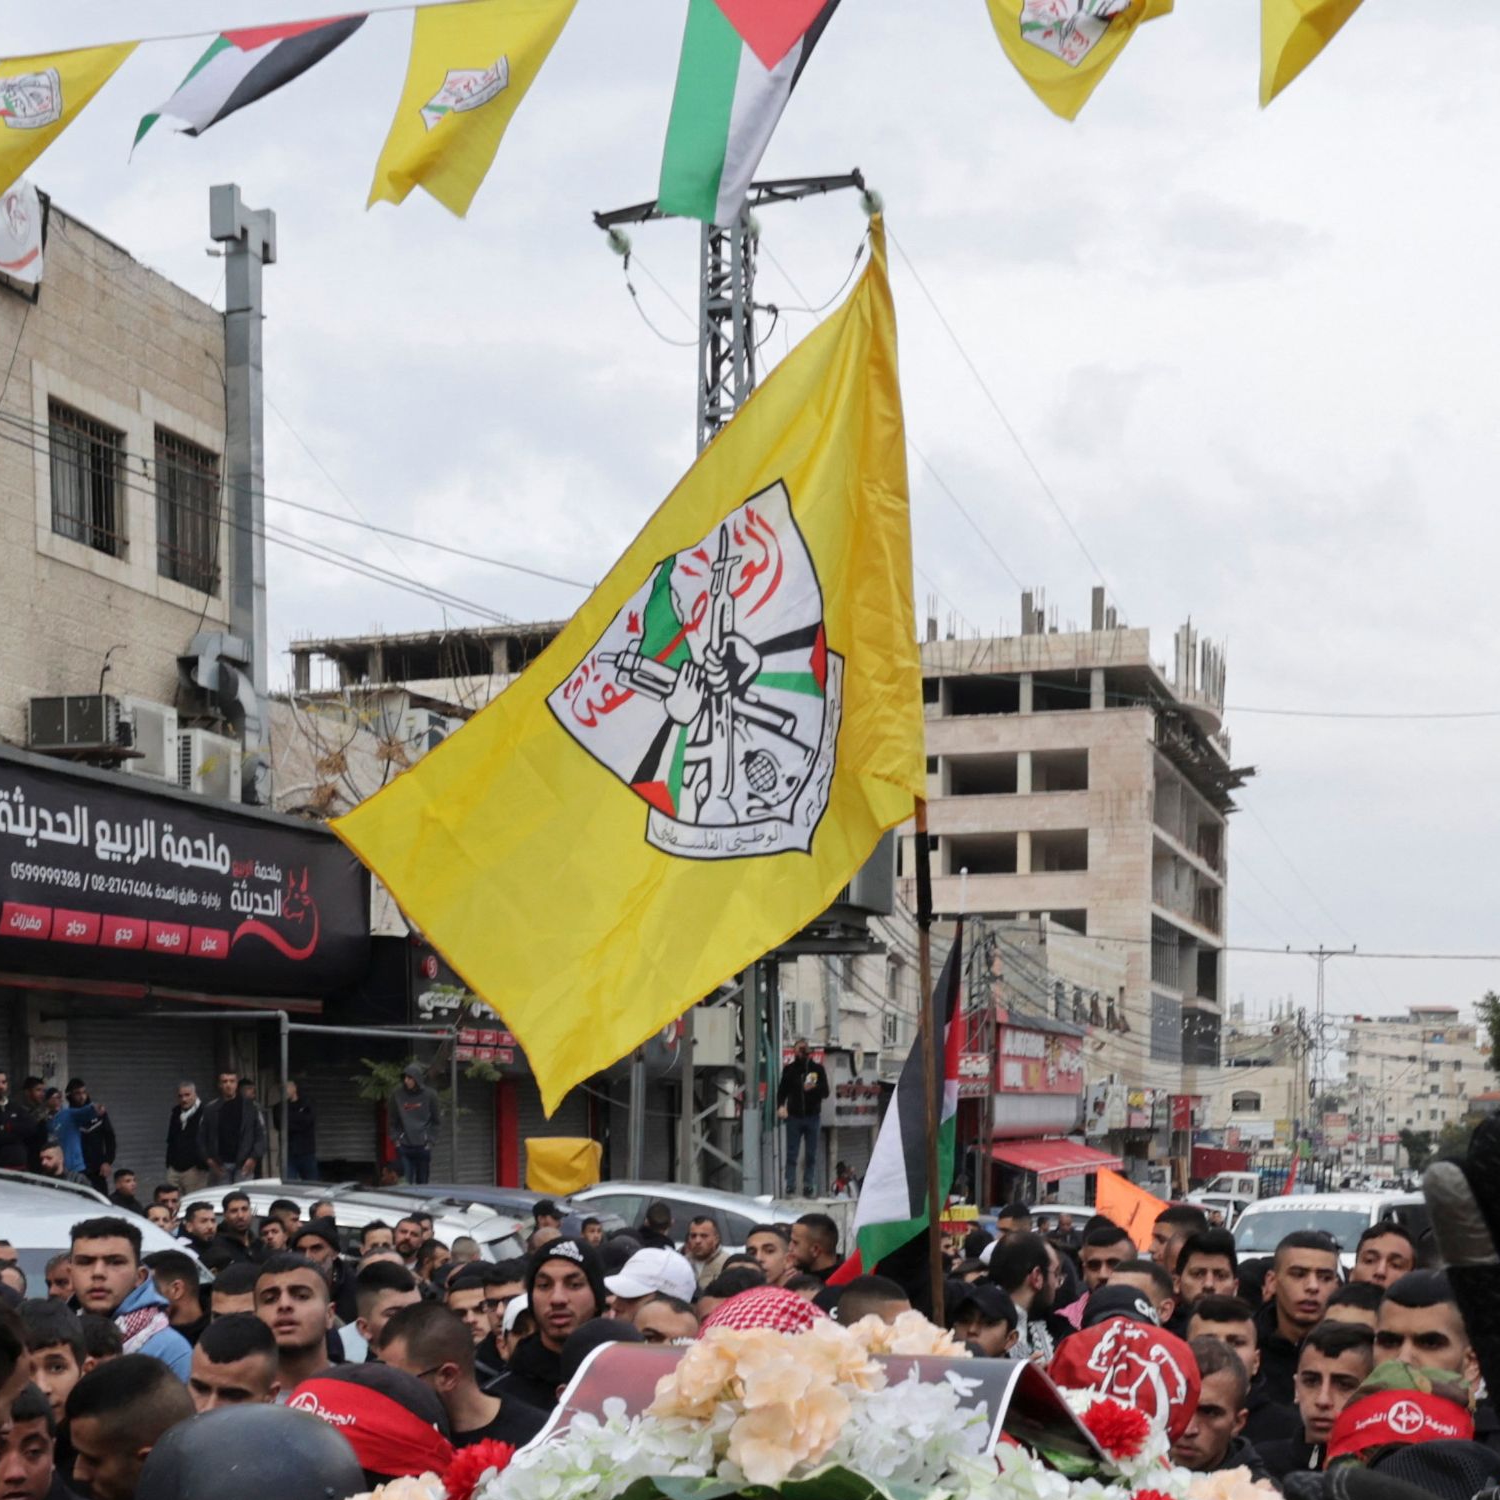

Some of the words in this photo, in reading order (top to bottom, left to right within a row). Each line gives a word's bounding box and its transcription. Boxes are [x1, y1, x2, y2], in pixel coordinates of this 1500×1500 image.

[94, 819, 156, 866] الربيع
[160, 822, 231, 875] ملحمة
[10, 861, 81, 889] 0599999328
[230, 882, 282, 919] الحديثة
